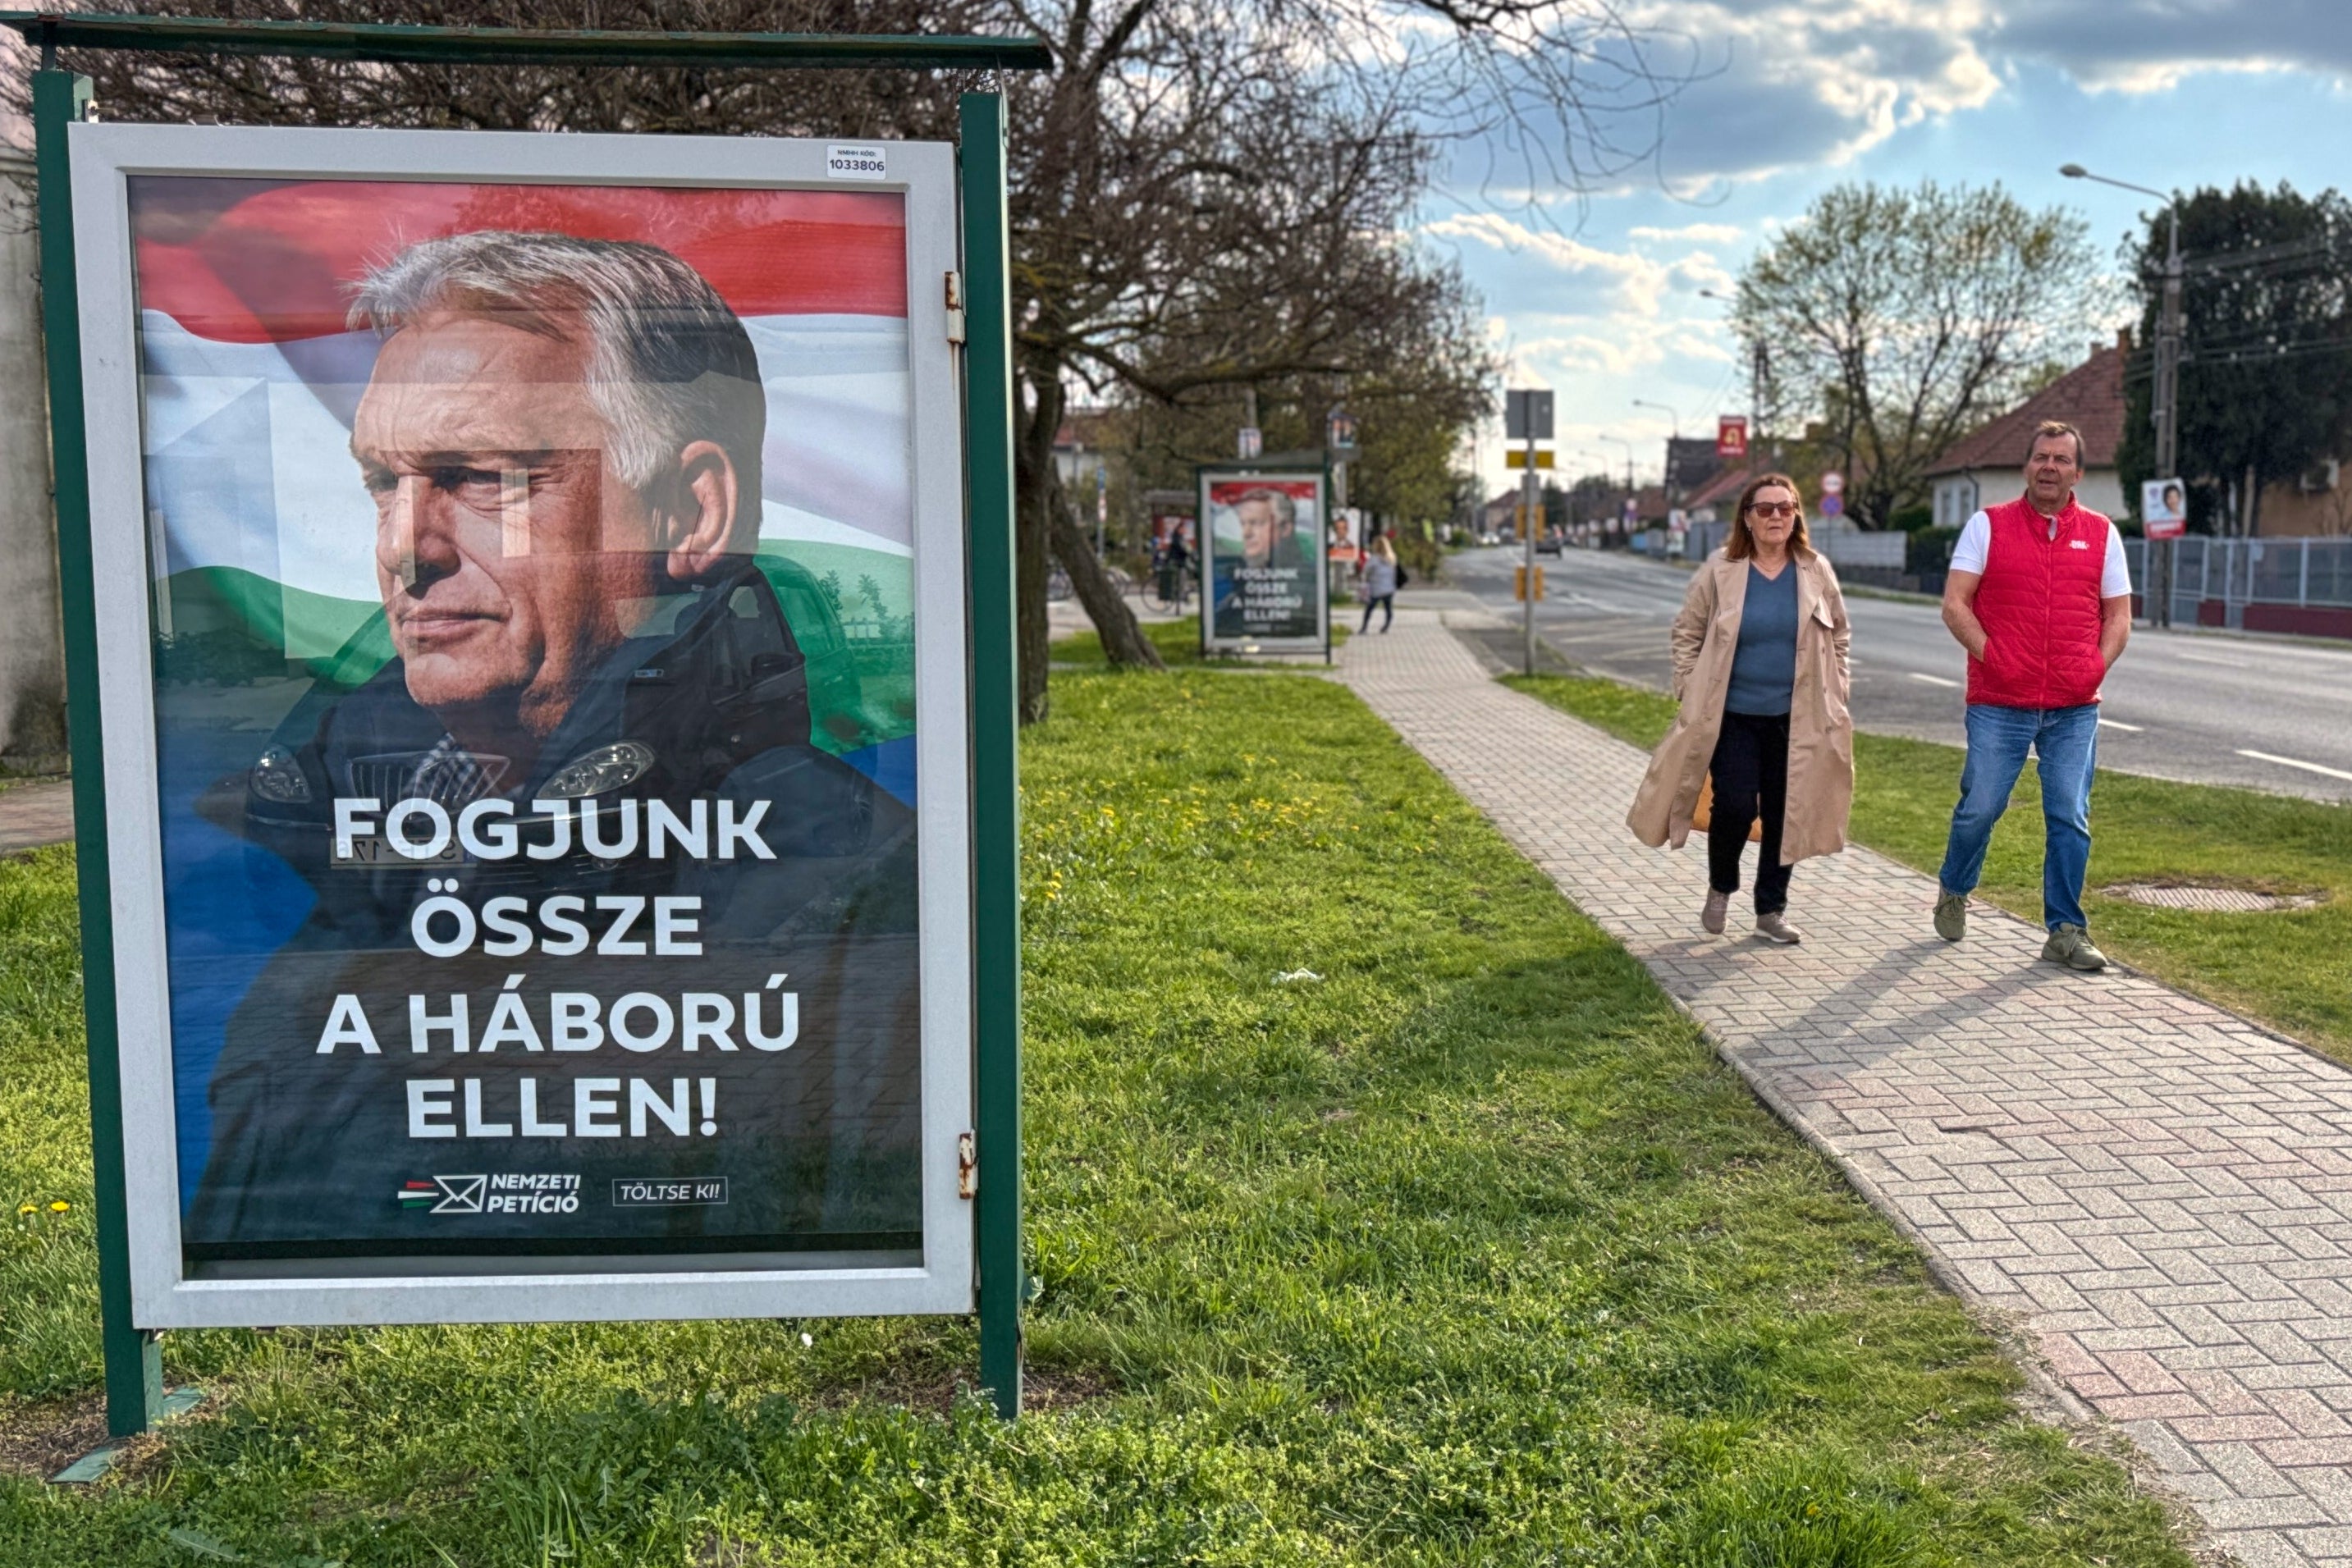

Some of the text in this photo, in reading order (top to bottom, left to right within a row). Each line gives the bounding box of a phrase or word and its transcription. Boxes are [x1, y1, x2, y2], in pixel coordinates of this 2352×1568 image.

[830, 159, 885, 171] 1033806
[333, 798, 777, 860] FOGJUNK
[411, 878, 703, 958] ÖSSZE
[316, 973, 799, 1054] A HÁBORÚ
[406, 1077, 717, 1137] ELLEN!
[491, 1173, 581, 1190] NEMZETI
[620, 1182, 721, 1200] TÖLTSE KI!
[487, 1191, 579, 1214] PETÍCIÓ
